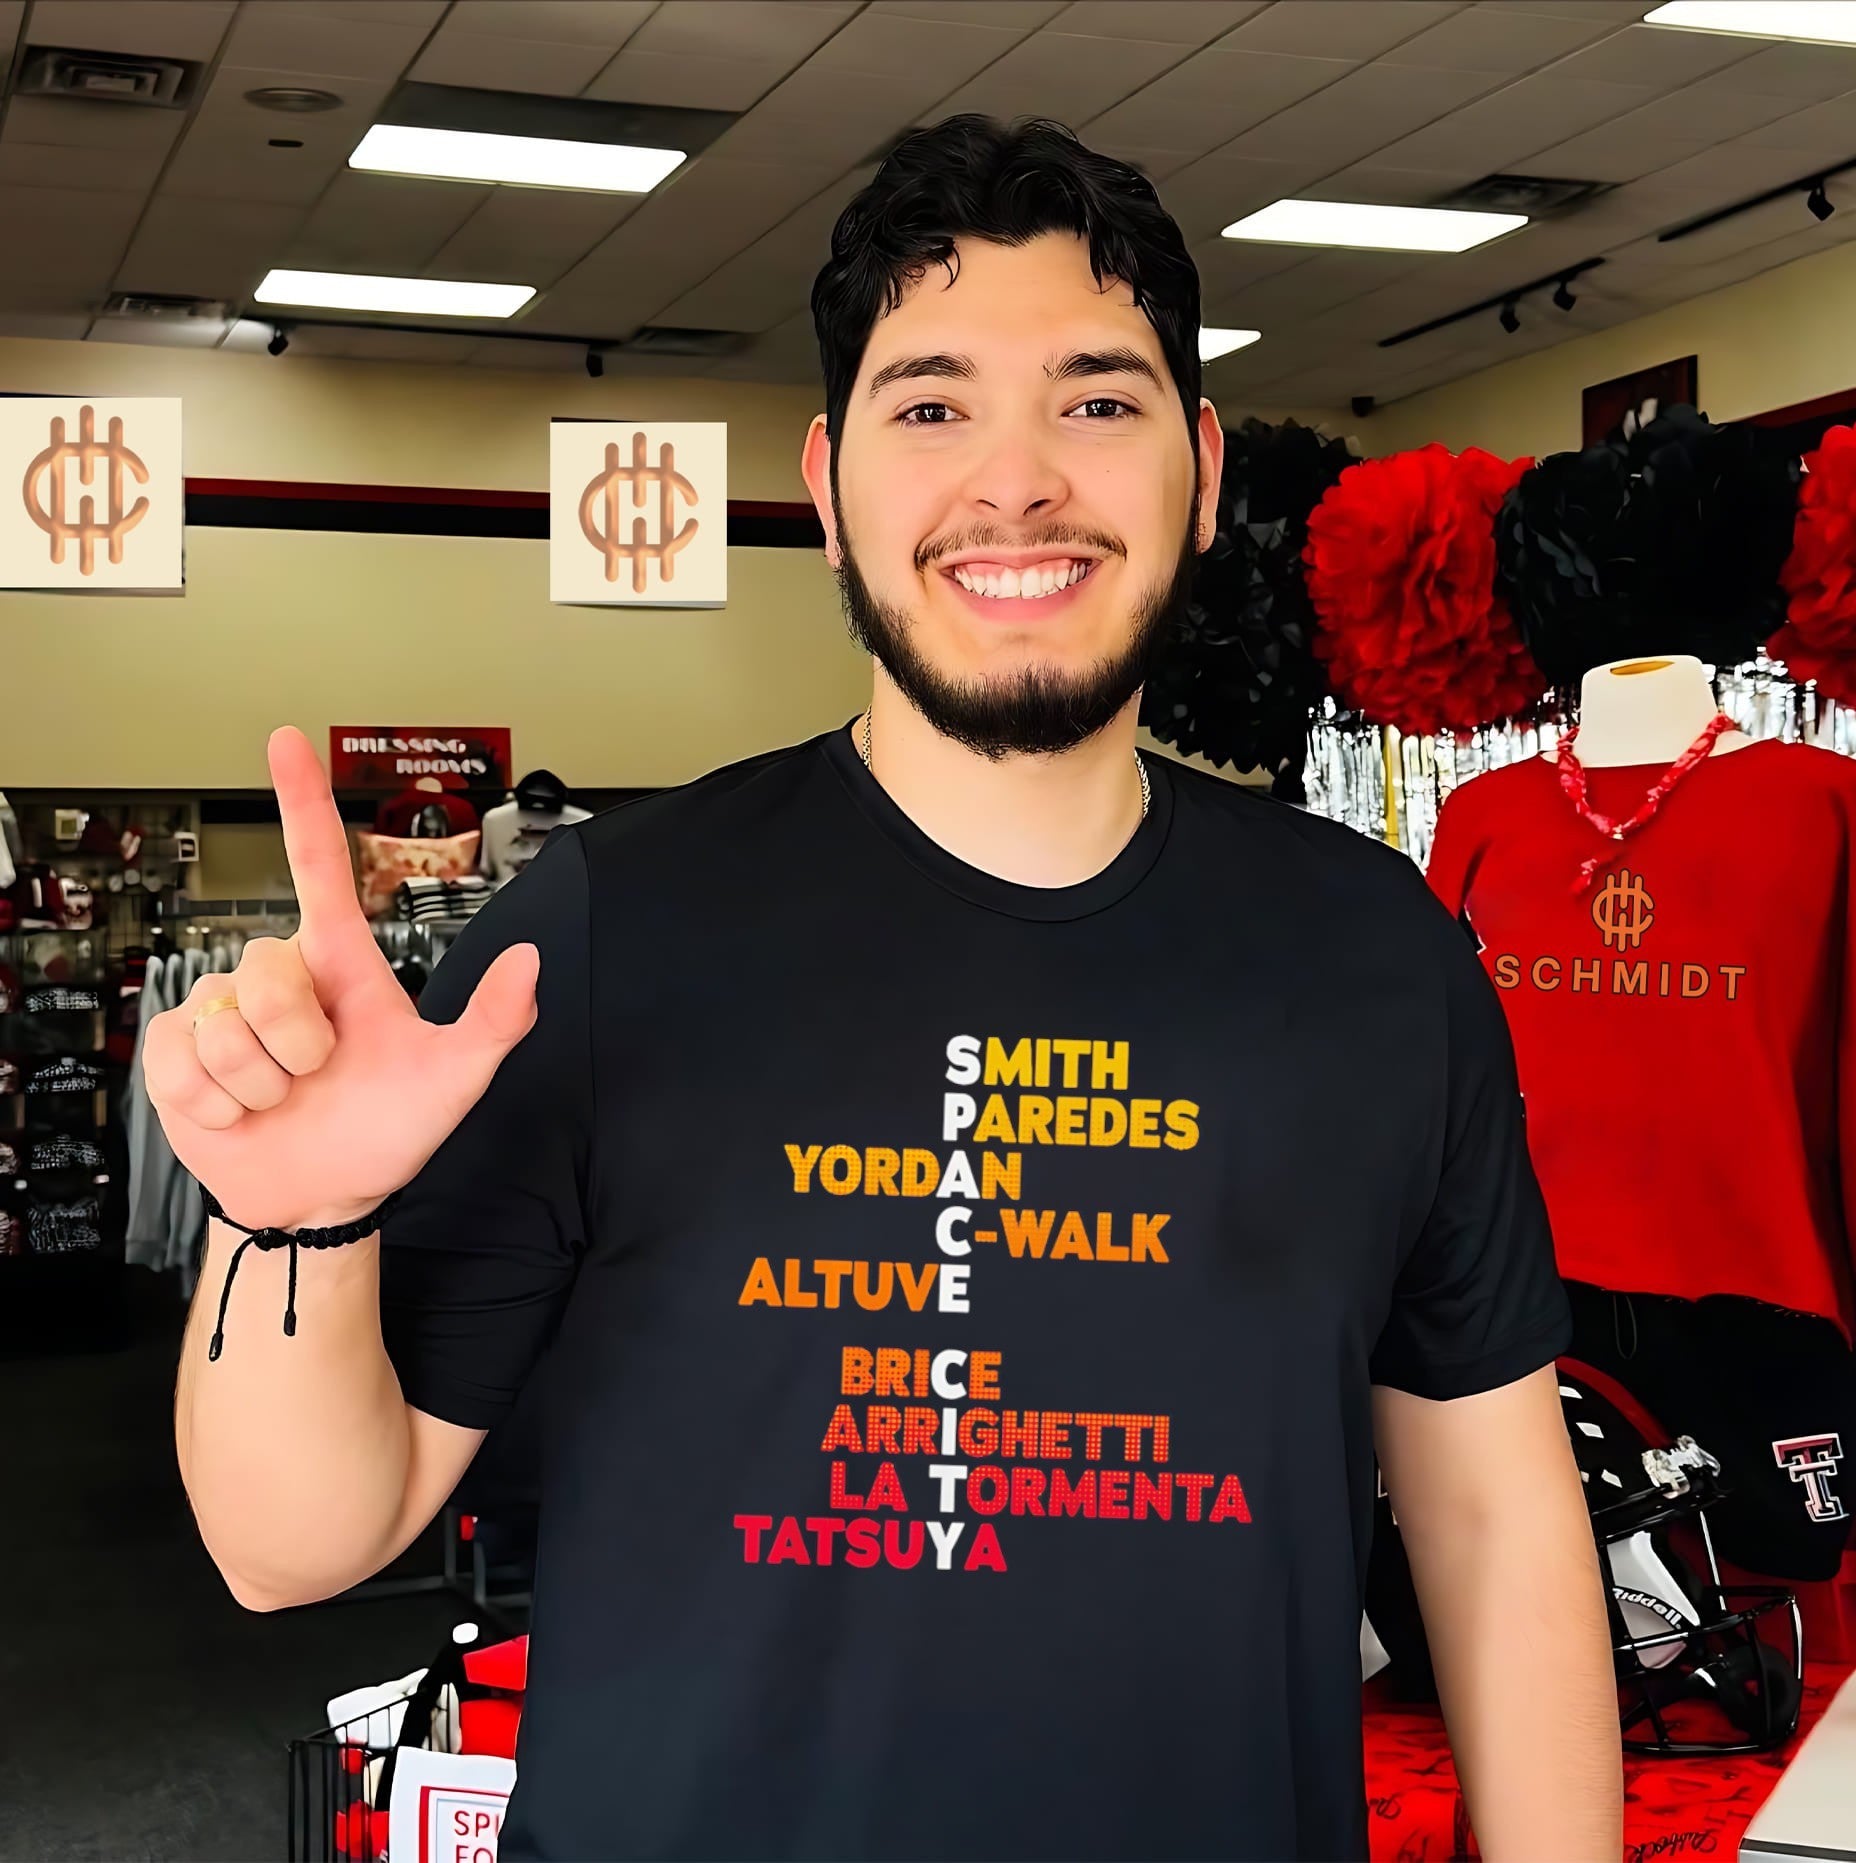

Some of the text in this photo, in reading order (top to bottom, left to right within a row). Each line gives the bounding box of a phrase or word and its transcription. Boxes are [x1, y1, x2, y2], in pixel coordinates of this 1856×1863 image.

[342, 737, 466, 753] DRESSING
[396, 758, 487, 775] ROOMS
[1494, 953, 1747, 1001] SCHMIDT
[946, 1035, 1129, 1090] SMITH
[943, 1093, 1199, 1150] PAREDES
[784, 1144, 1022, 1200] YORDAN
[936, 1206, 1171, 1263] C-WALK
[738, 1257, 970, 1313] ALTUVE
[841, 1346, 1001, 1400] BRICE
[821, 1404, 1169, 1463] ARRIGHETTI
[830, 1461, 1252, 1523] LA TORMENTA
[734, 1515, 1007, 1572] TATSUYA
